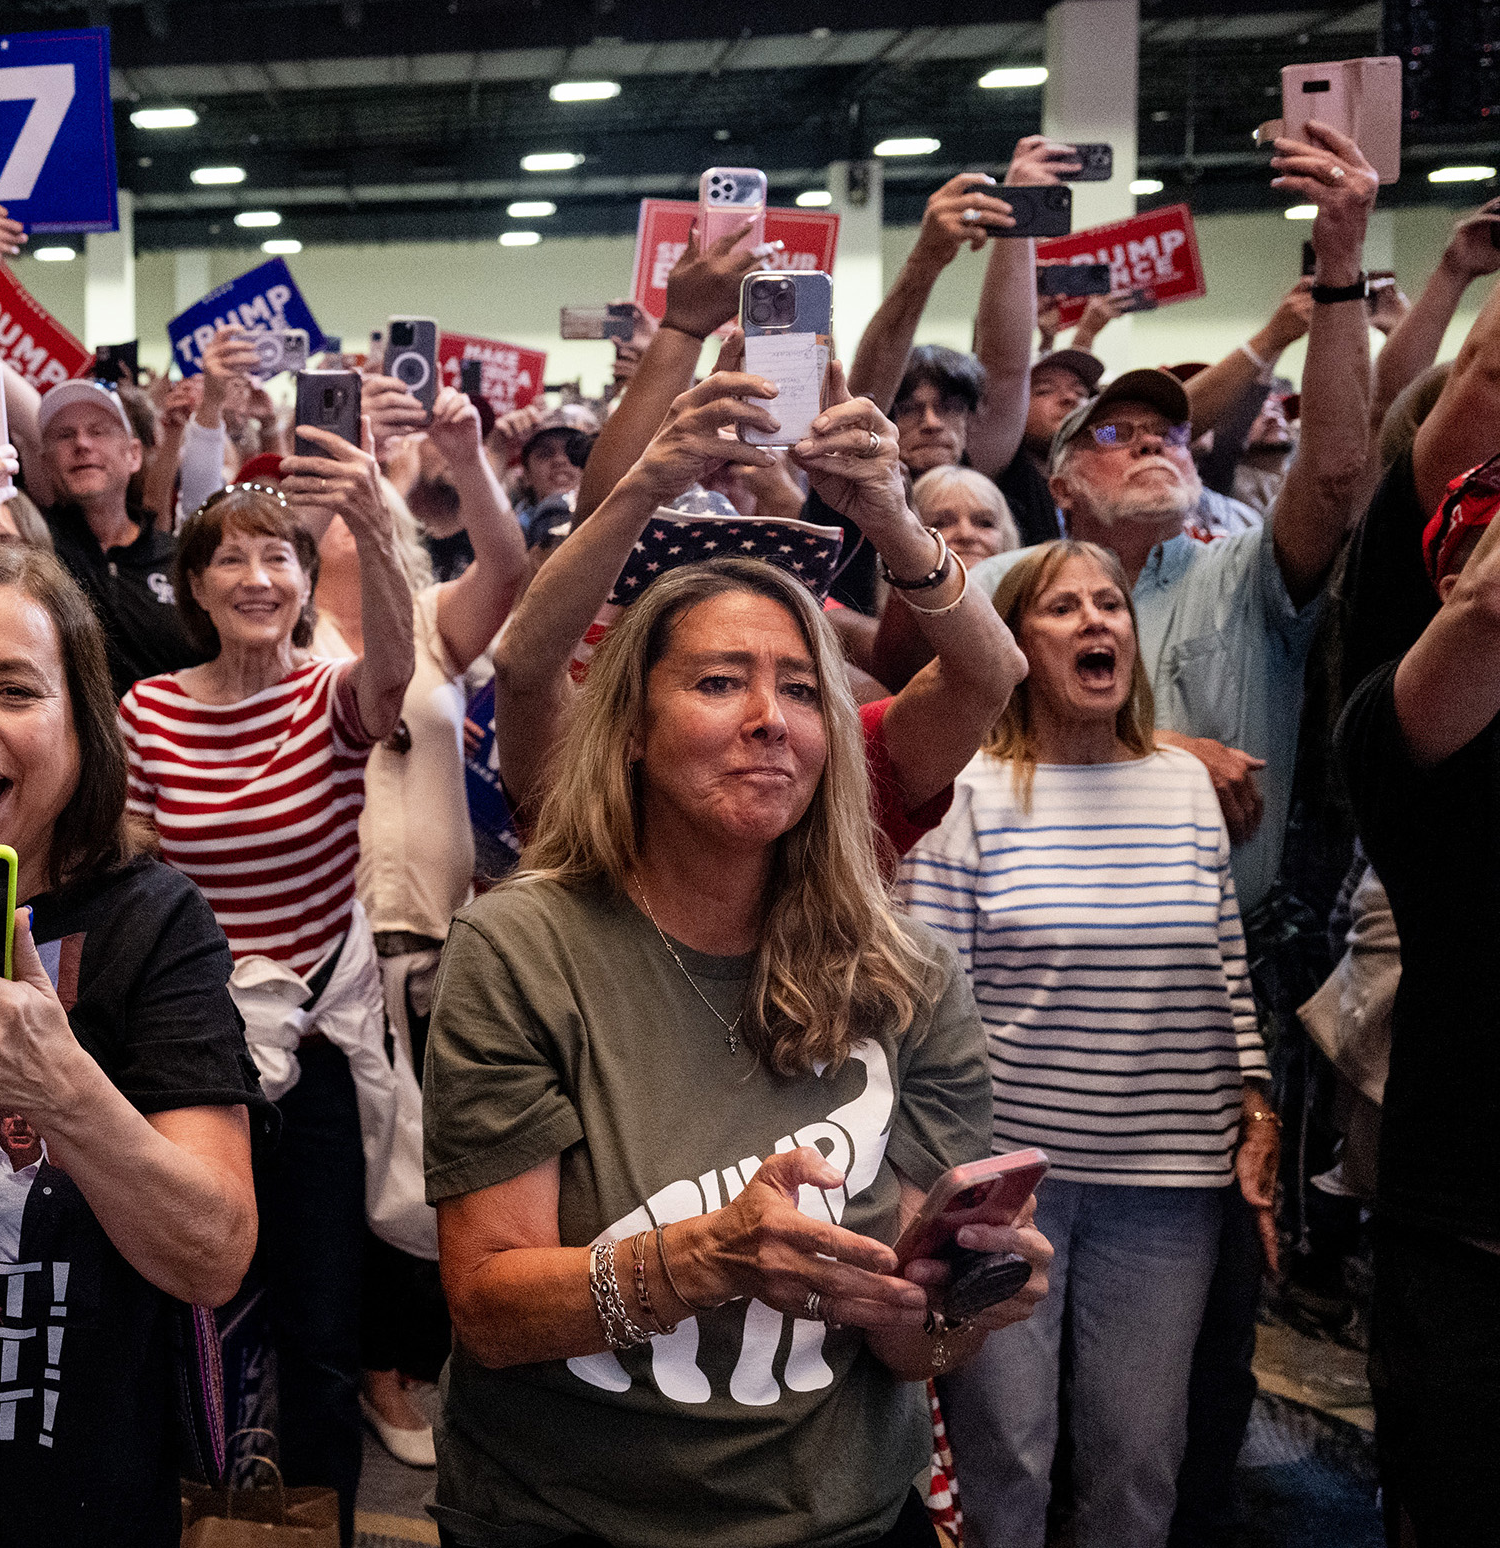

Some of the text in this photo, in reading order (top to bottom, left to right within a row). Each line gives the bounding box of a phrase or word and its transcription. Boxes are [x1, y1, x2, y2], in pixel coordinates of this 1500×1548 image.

[1070, 229, 1186, 268] UMP
[1108, 252, 1177, 292] NCE
[463, 345, 520, 367] MAKE
